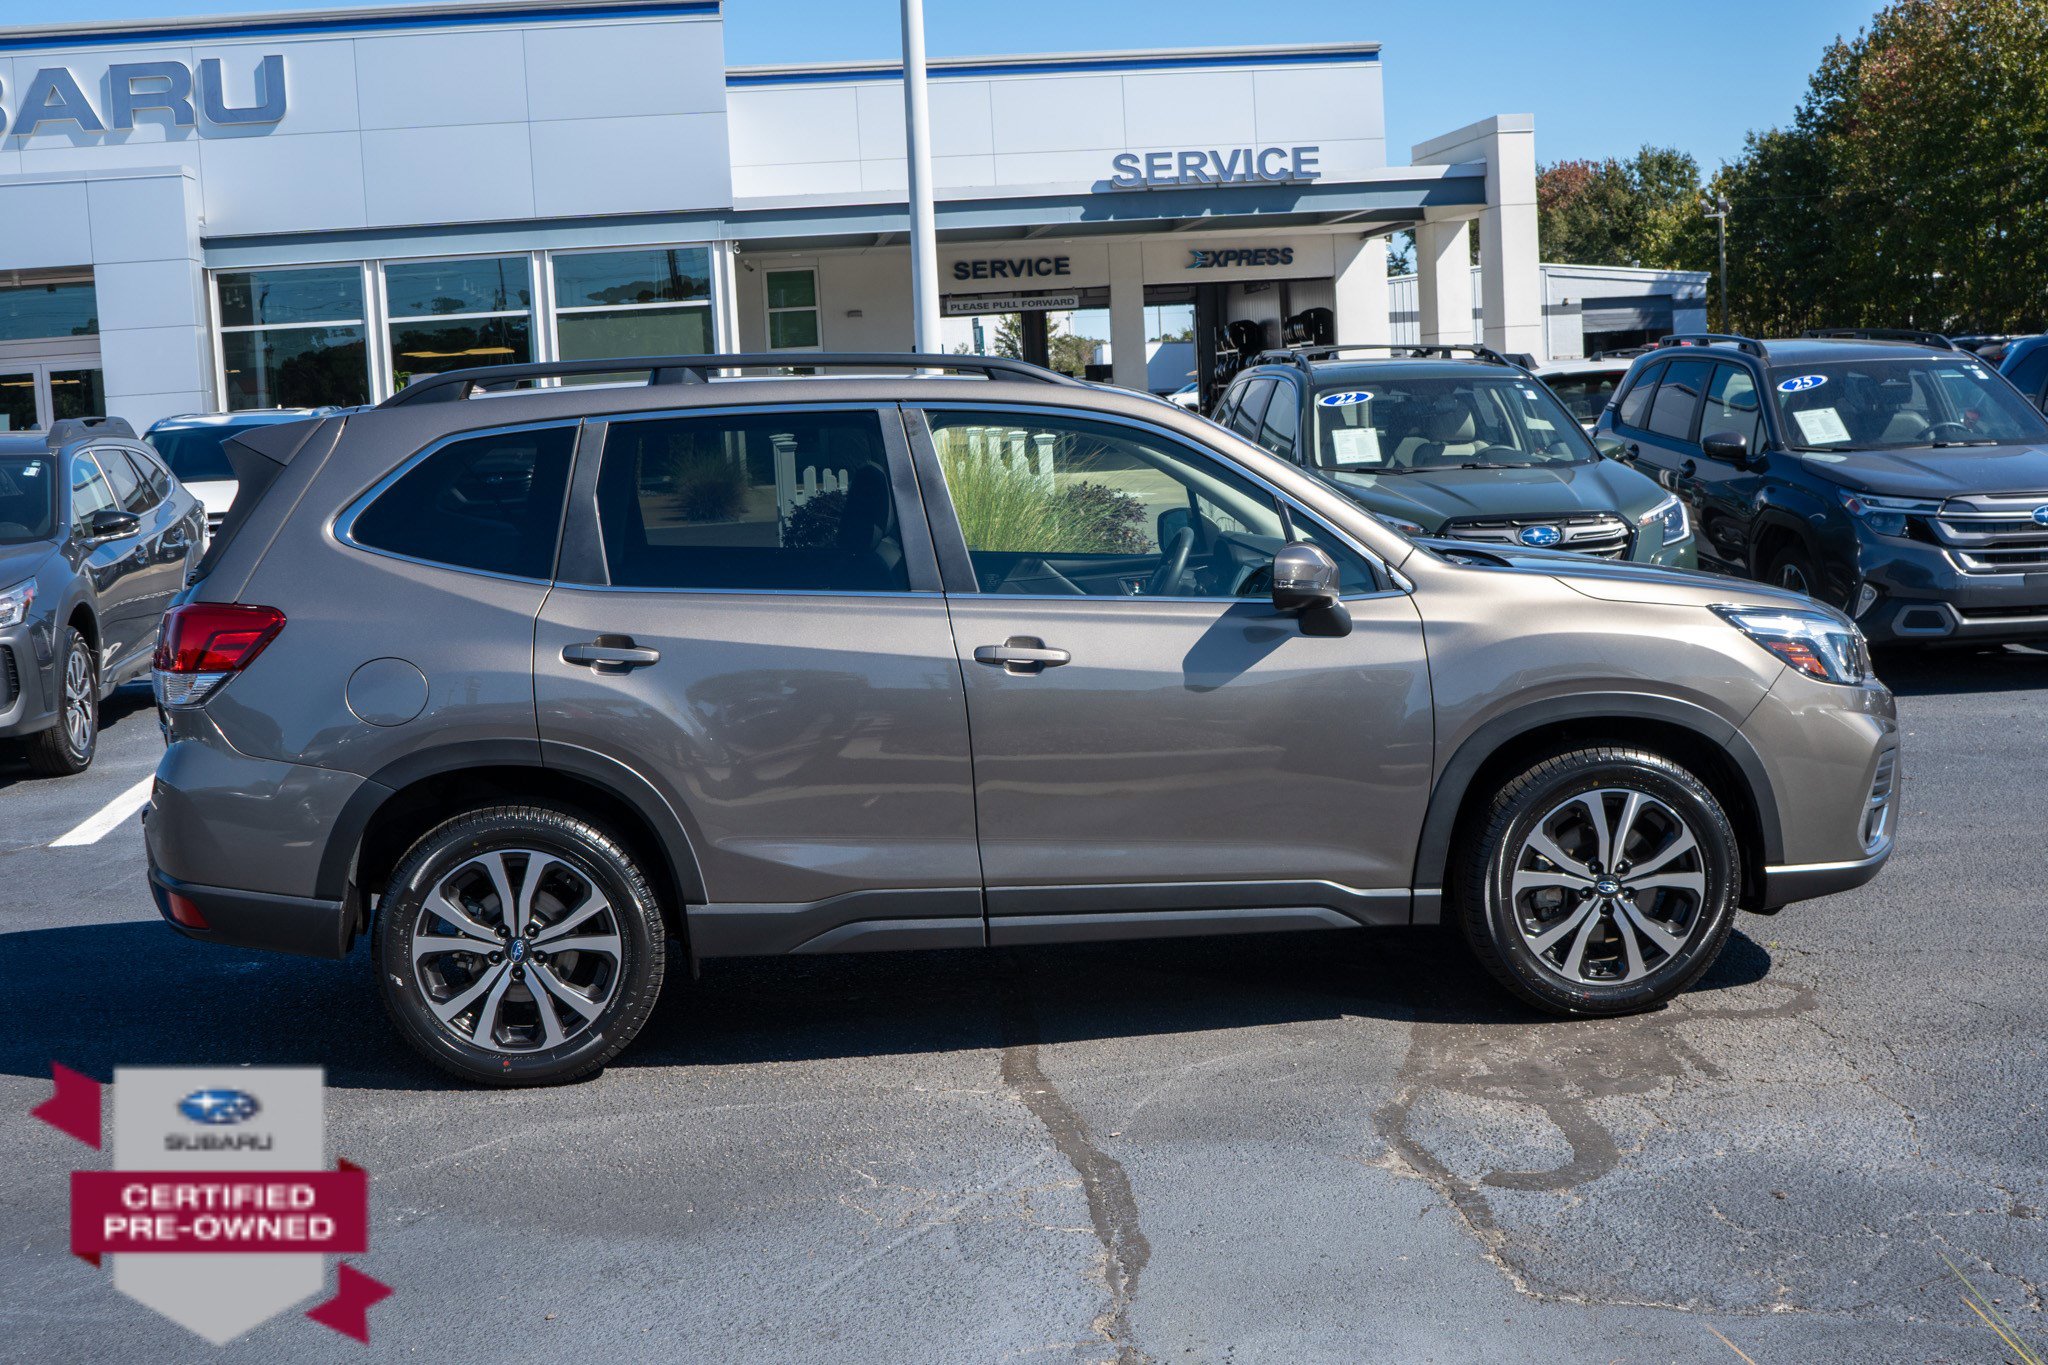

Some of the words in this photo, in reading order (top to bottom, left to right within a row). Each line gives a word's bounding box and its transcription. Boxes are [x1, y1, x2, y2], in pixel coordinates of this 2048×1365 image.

[0, 54, 287, 136] ARU
[1111, 146, 1322, 187] SERVICE
[953, 256, 1071, 281] SERVICE
[1188, 247, 1294, 269] EXPRESS
[950, 302, 990, 312] PLEASE
[992, 300, 1019, 310] PULL
[1021, 298, 1075, 309] FORWARD
[1792, 376, 1813, 390] 25
[1334, 392, 1357, 405] 22
